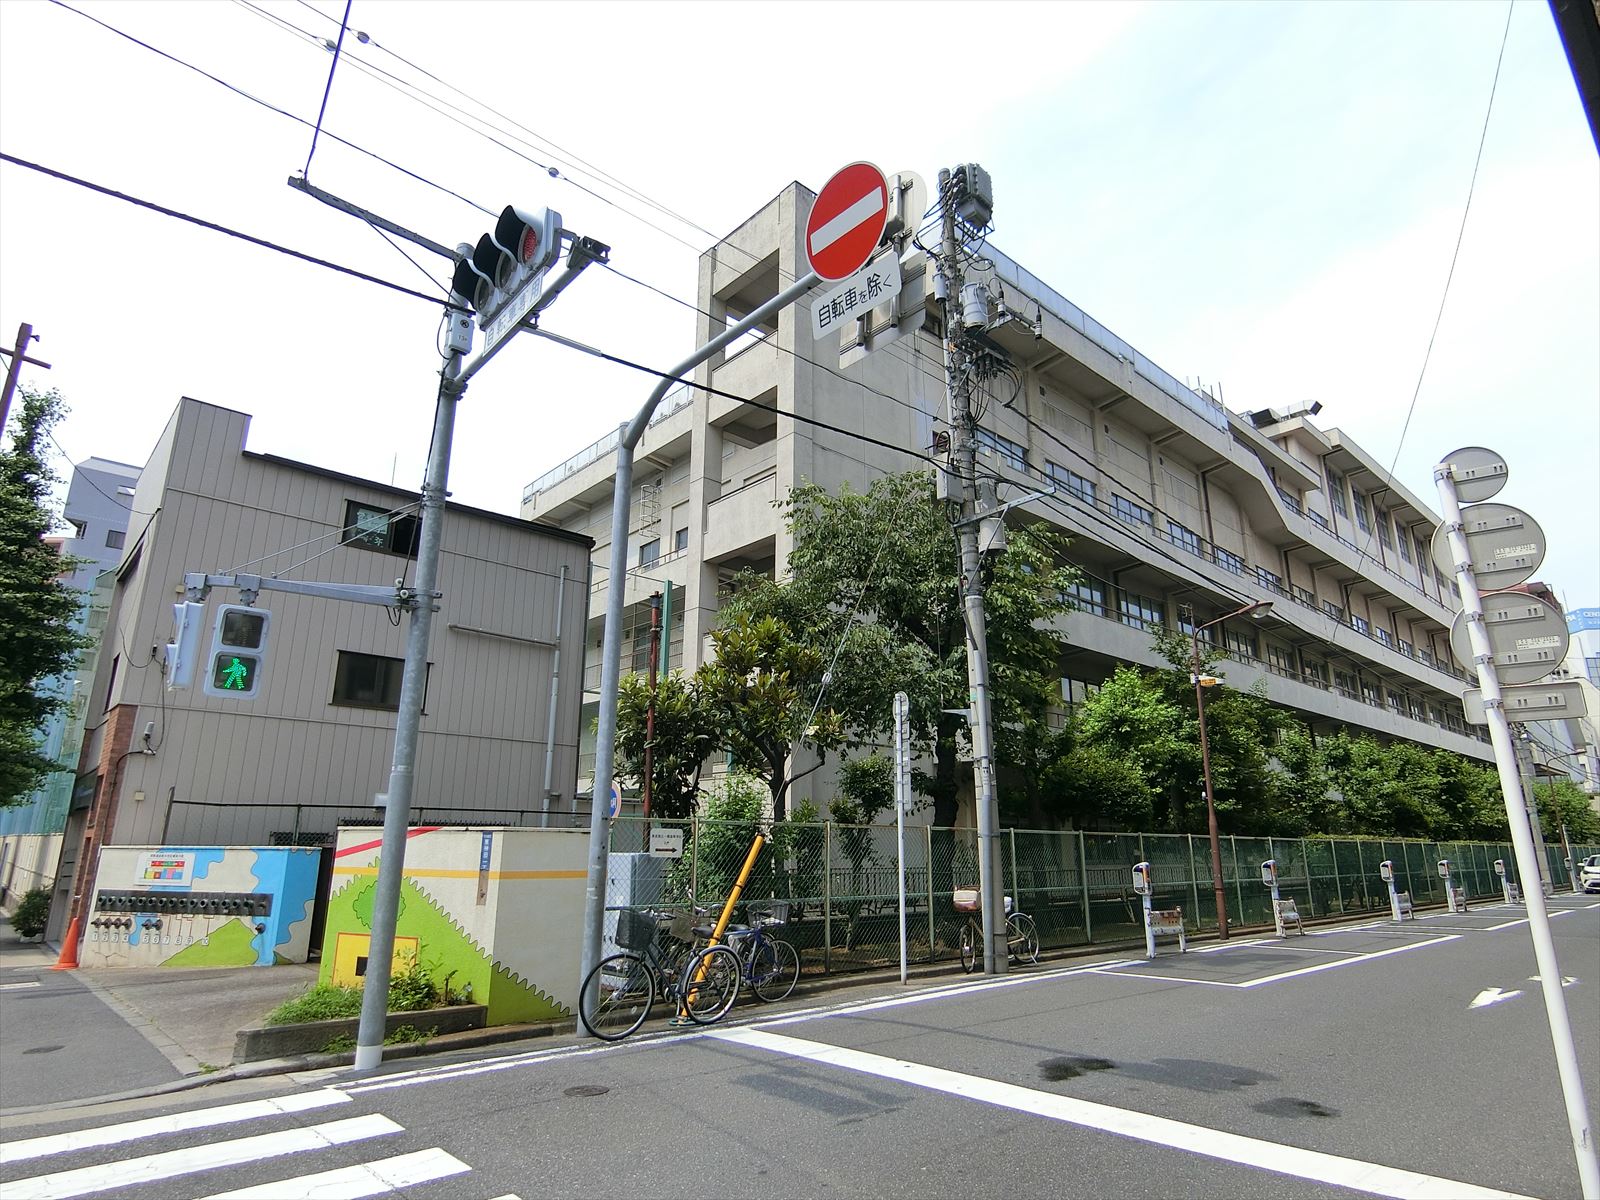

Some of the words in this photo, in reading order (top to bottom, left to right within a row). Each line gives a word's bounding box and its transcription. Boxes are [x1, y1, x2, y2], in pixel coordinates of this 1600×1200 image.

[818, 273, 891, 328] 自転車を除く
